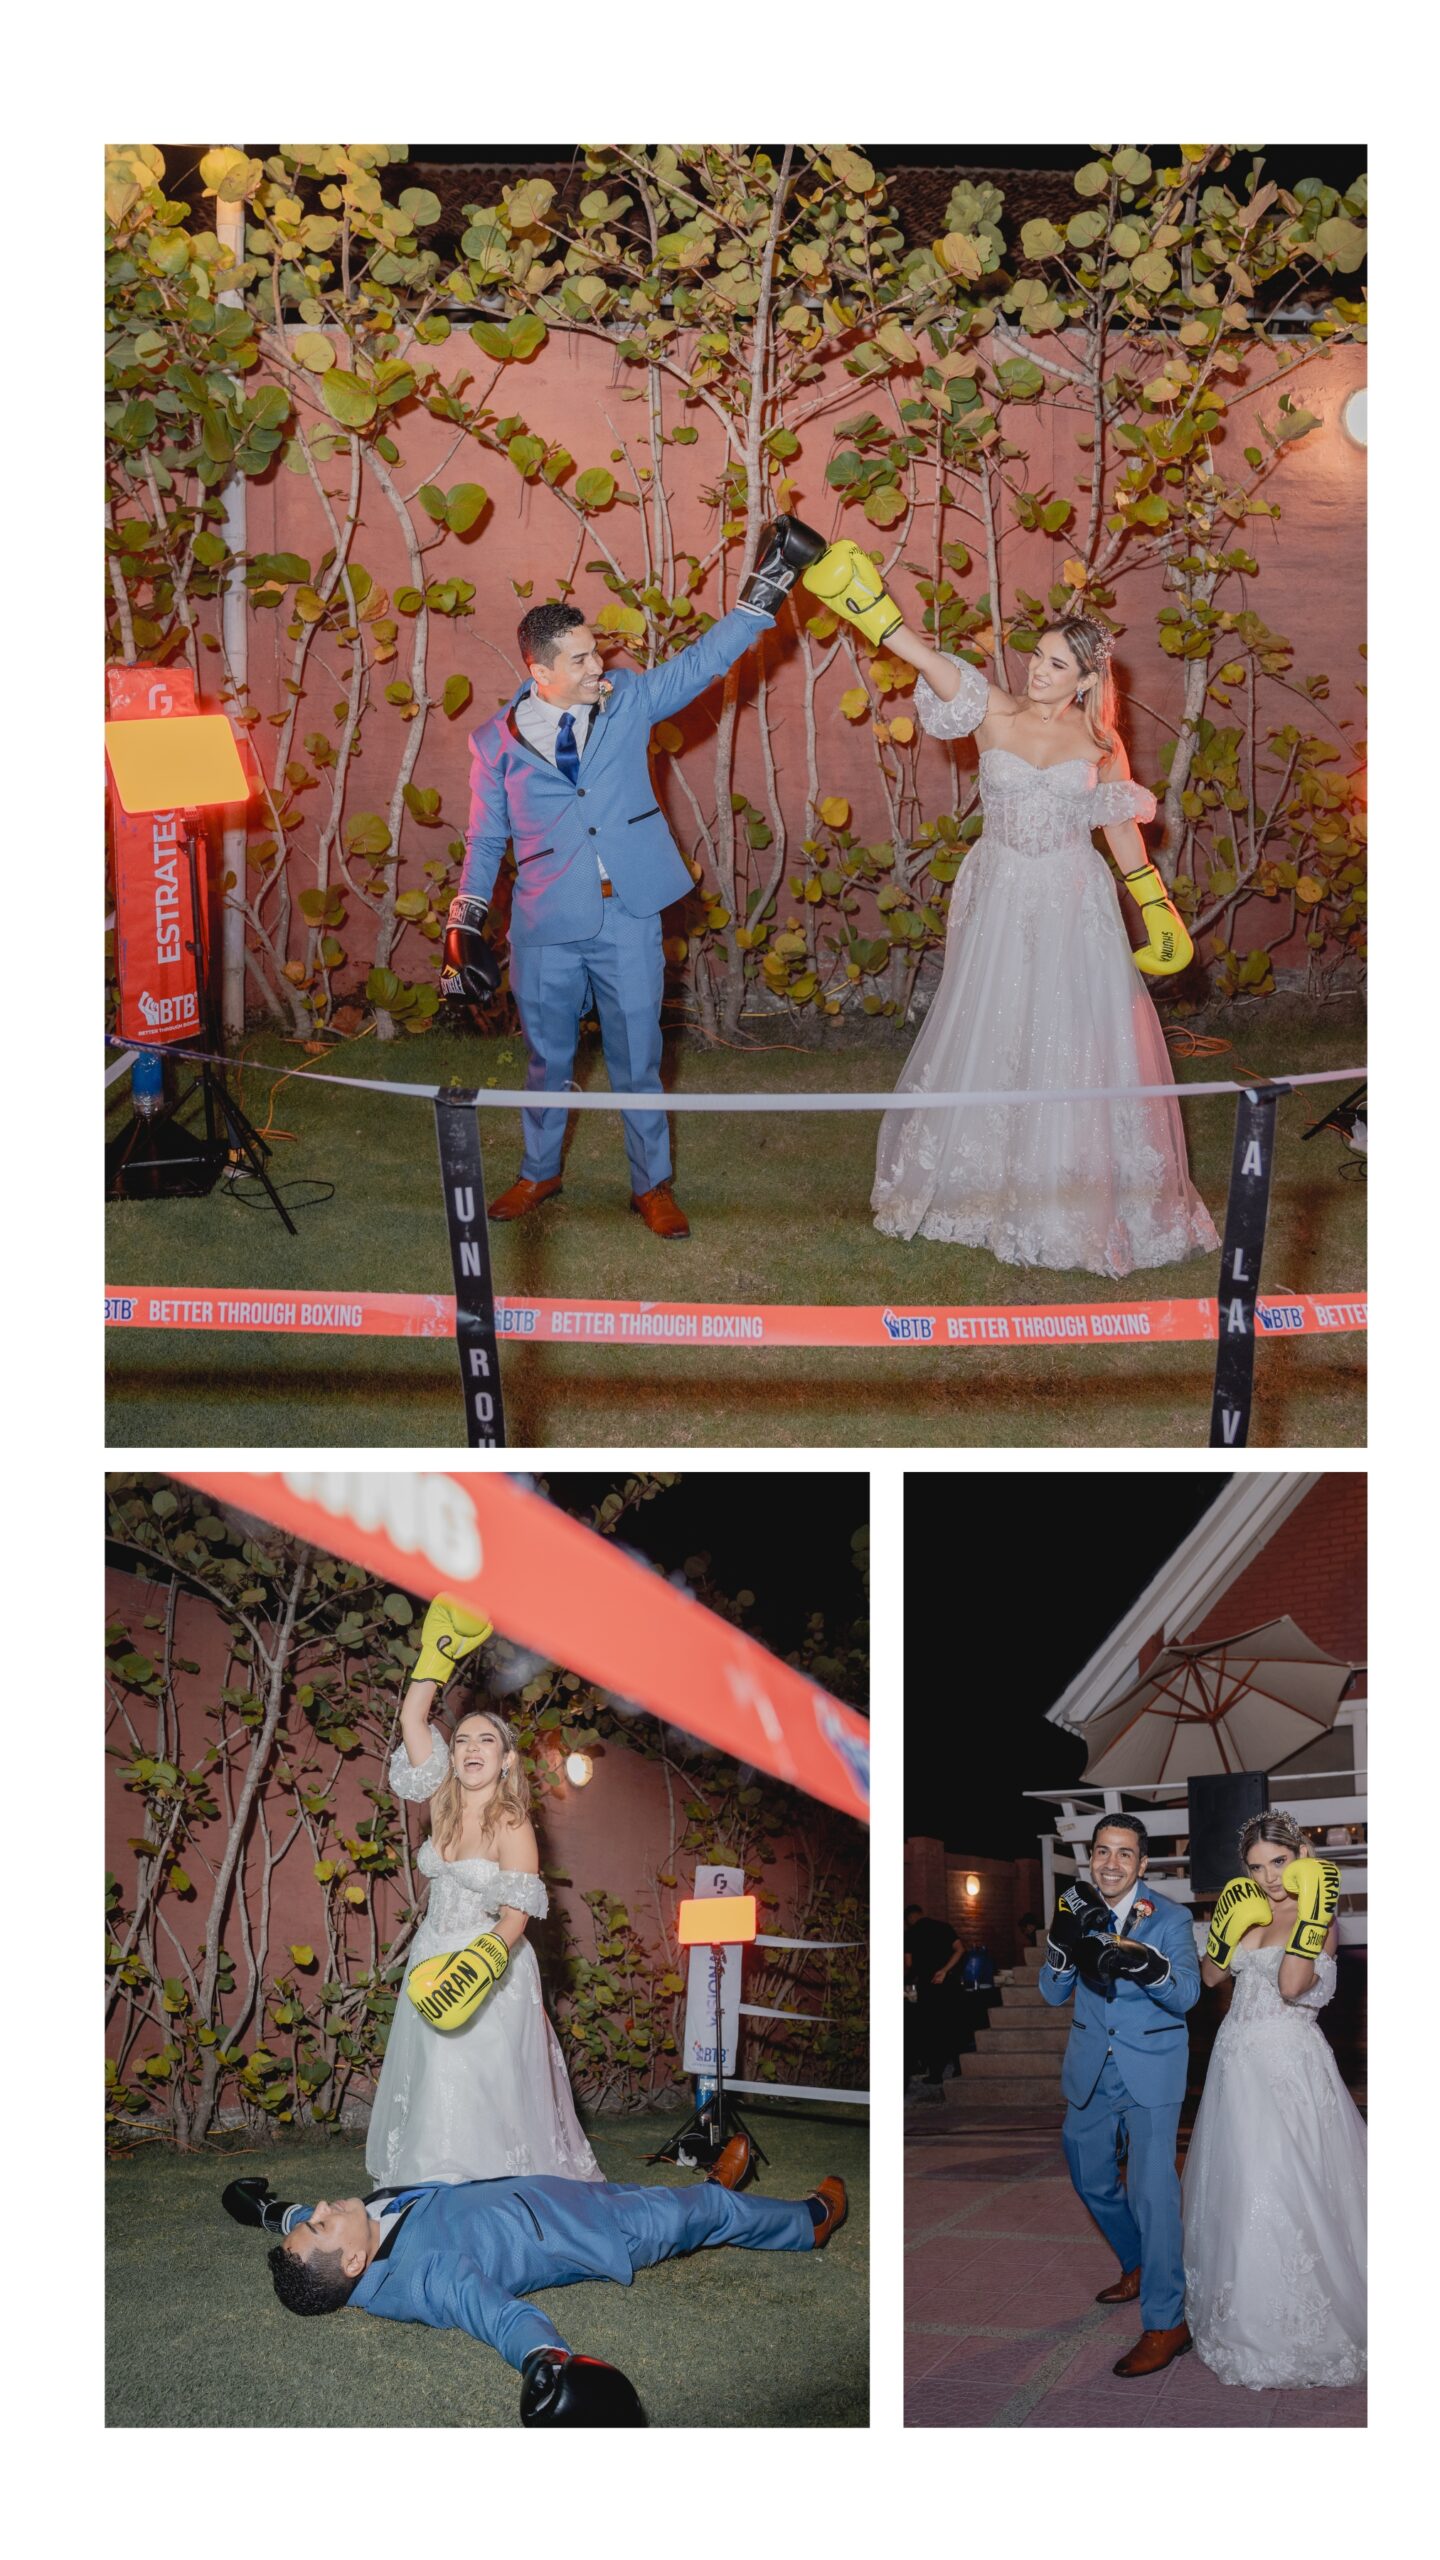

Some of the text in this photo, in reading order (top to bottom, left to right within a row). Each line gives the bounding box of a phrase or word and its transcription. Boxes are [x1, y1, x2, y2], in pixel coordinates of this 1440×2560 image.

[153, 811, 181, 964] ESTRATE
[160, 993, 195, 1025] BTB
[1241, 1141, 1262, 1177] A
[149, 1299, 213, 1323] BETTER
[218, 1302, 296, 1326] THROUGH
[300, 1303, 363, 1328] BOXING
[503, 1310, 763, 1338] BTB BETTER THROUGH BOXING
[901, 1313, 1150, 1339] BTB BETTER THROUGH BOXING
[1272, 1303, 1367, 1328] BTB BETTE
[469, 1348, 496, 1448] RO
